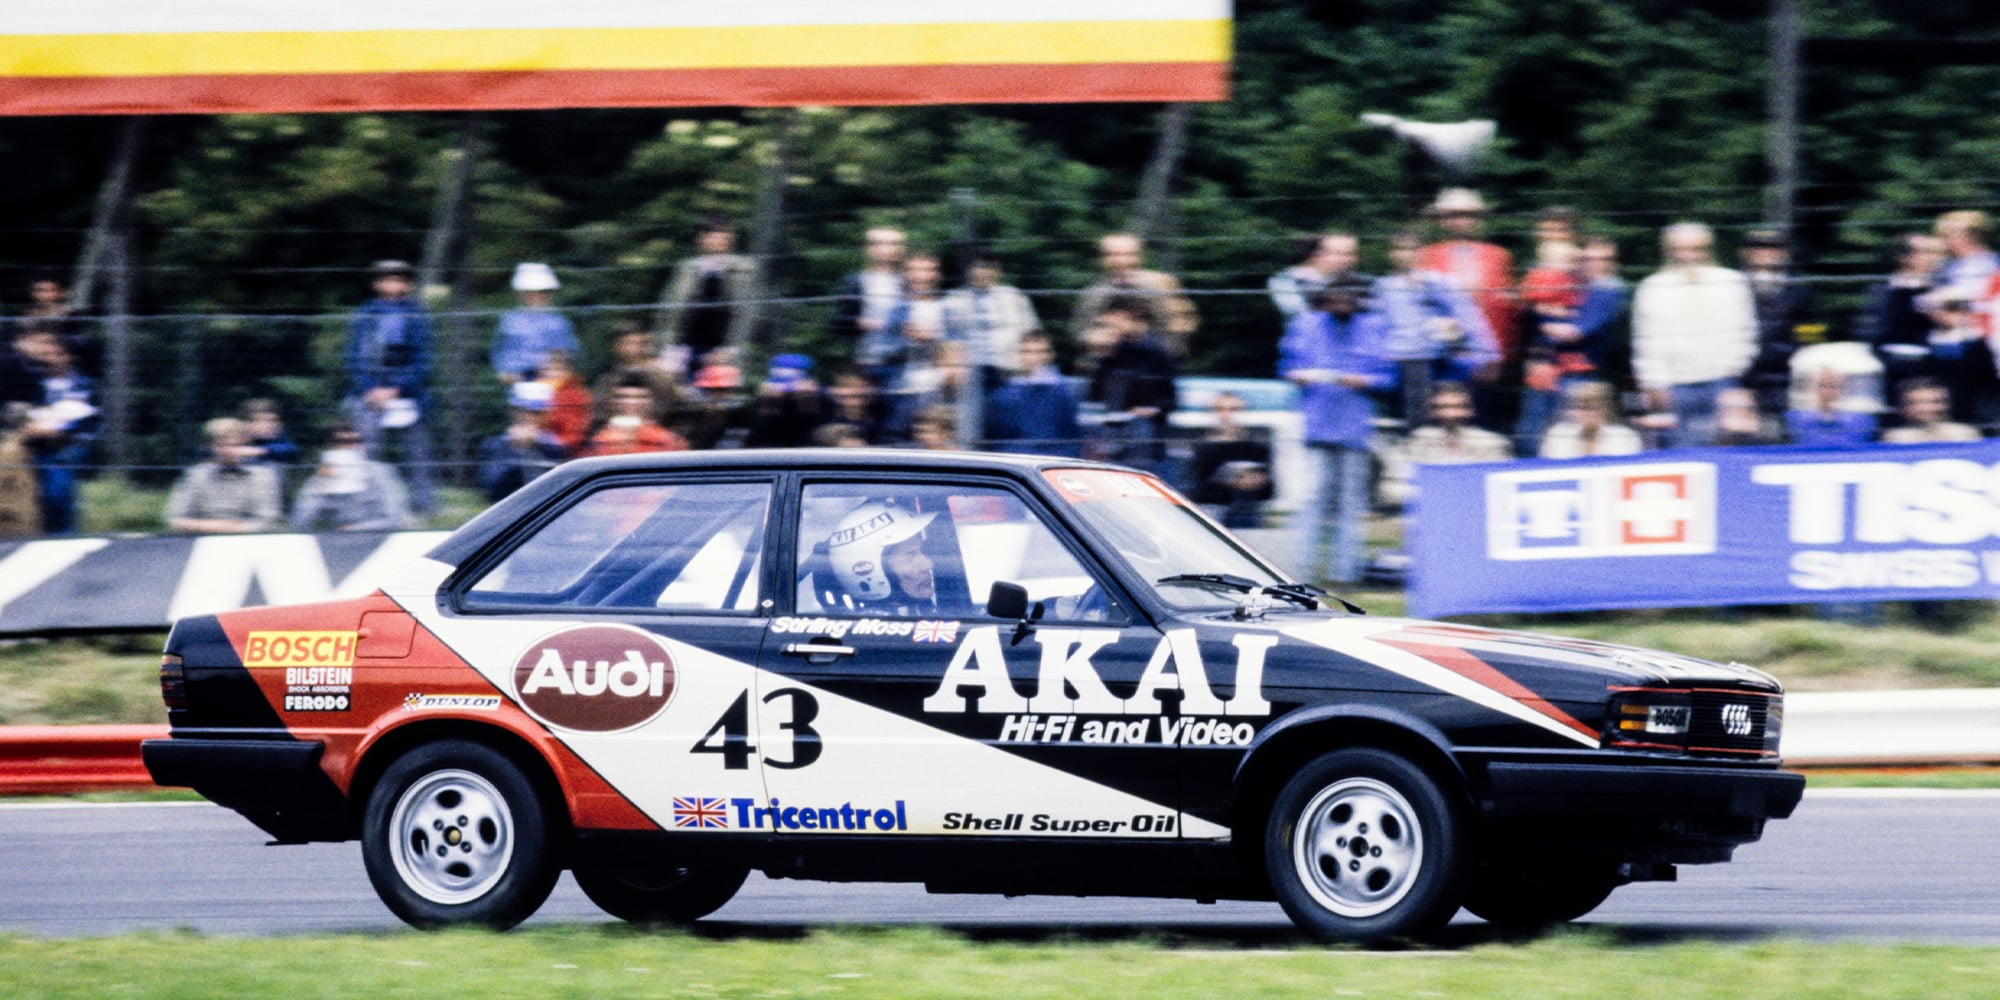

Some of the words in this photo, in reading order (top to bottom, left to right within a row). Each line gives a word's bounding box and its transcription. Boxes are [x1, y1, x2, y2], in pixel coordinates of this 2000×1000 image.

[1751, 458, 2000, 545] TIS
[1789, 550, 1981, 591] SWISS
[852, 618, 914, 636] Moss
[247, 636, 354, 662] BOSCH
[286, 667, 352, 685] BILSTEIN
[521, 649, 665, 697] Audi
[923, 626, 1279, 716] AKAI
[285, 695, 349, 710] FERODO
[424, 697, 498, 707] DUNLOP
[690, 687, 823, 770] 43
[999, 715, 1077, 743] Hi-Fi
[1081, 718, 1150, 744] and
[1160, 717, 1255, 746] Video
[731, 798, 908, 831] Tricentrol
[942, 812, 1024, 831] Shell
[1030, 814, 1127, 833] Super
[1131, 814, 1175, 833] Oil
